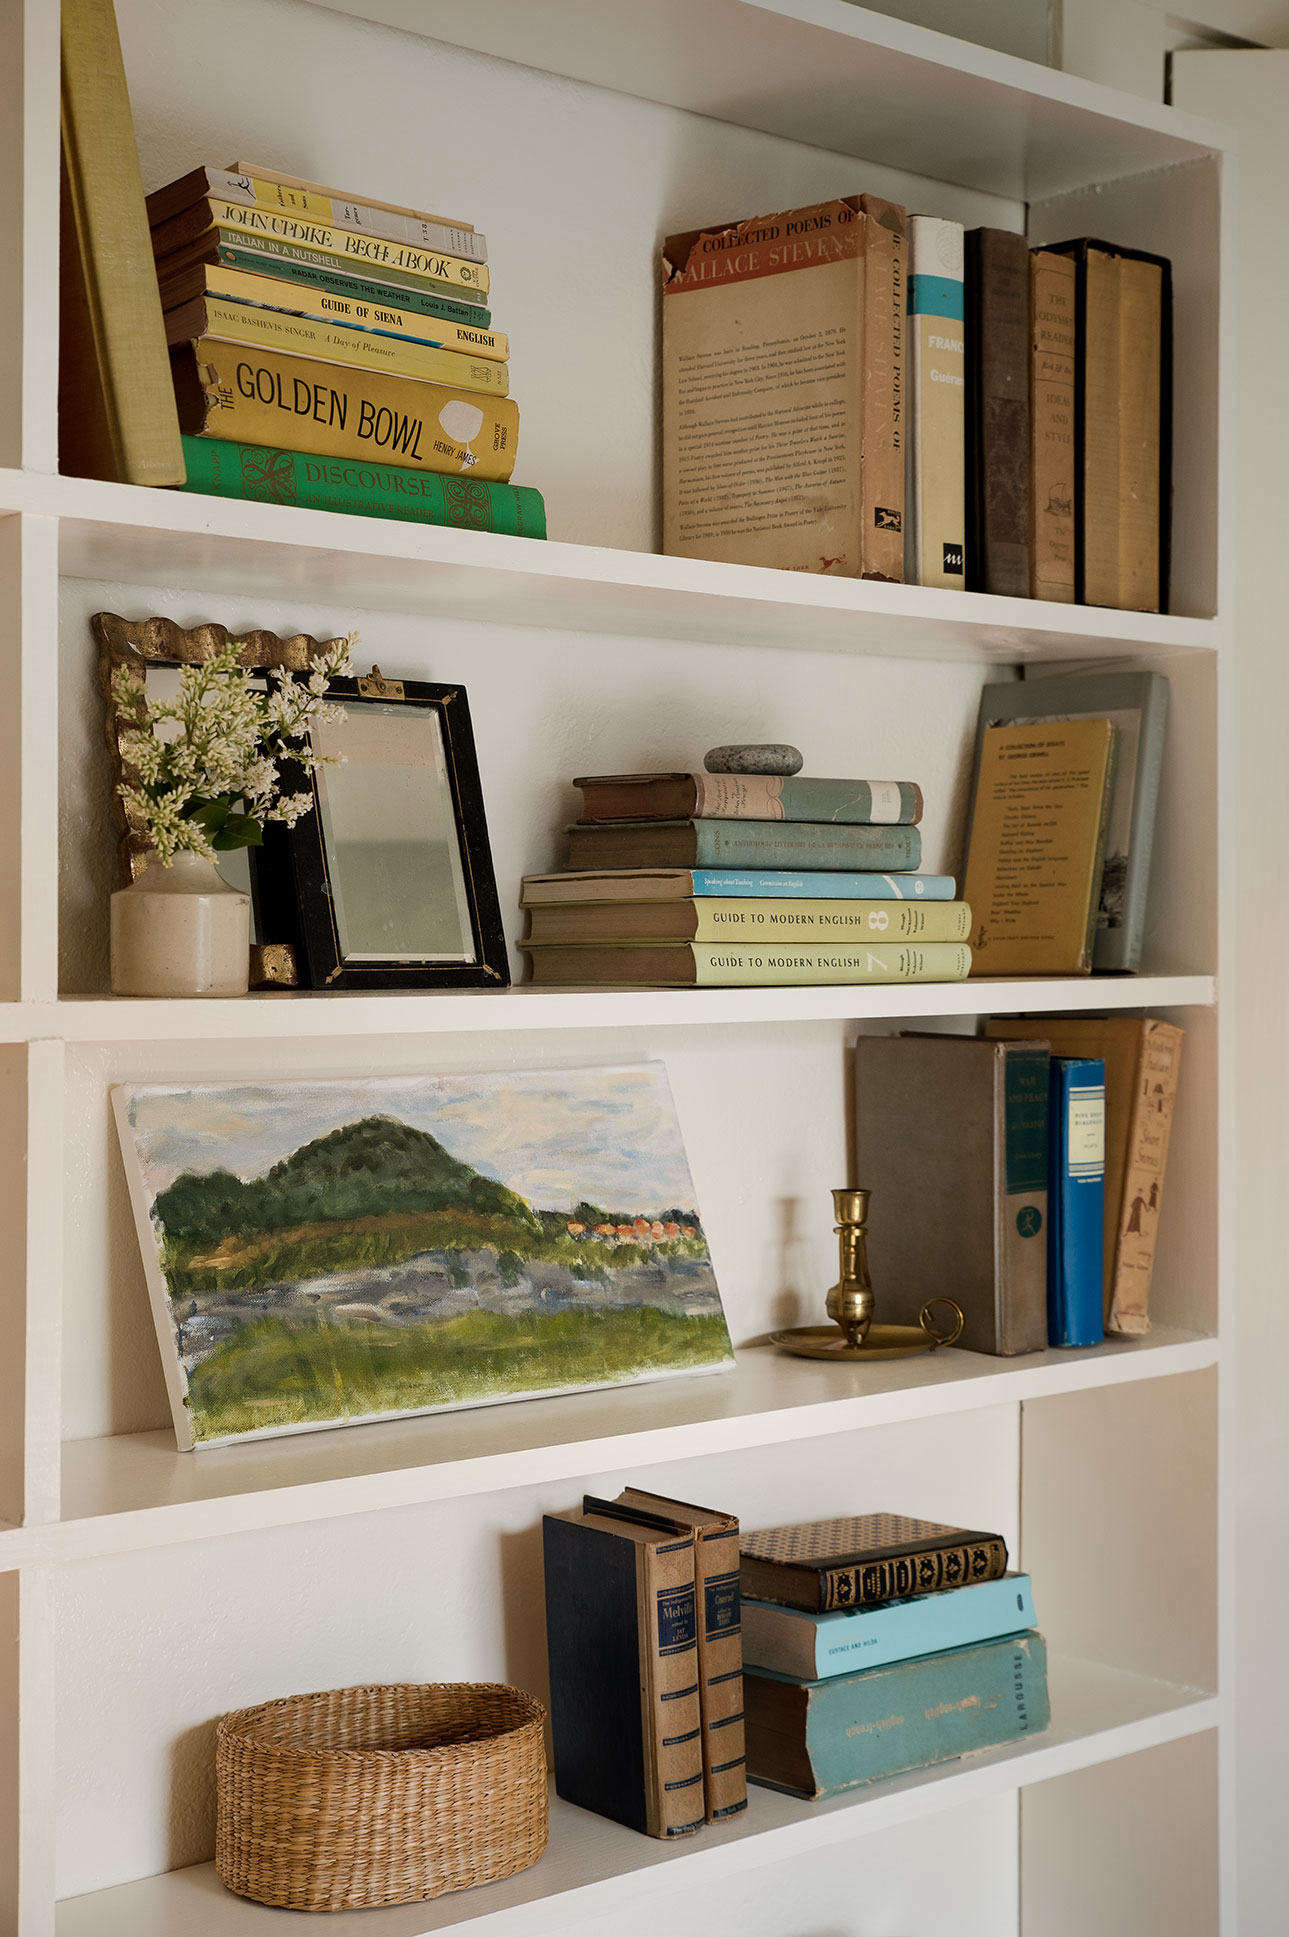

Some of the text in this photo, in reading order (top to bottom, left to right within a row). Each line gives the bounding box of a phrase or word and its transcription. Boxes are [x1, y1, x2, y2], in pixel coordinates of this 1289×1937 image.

[222, 206, 268, 230] JOHN
[272, 217, 333, 248] UPDIKE
[345, 236, 389, 261] BECH:
[392, 250, 404, 267] A
[405, 250, 452, 279] BOOK
[228, 232, 265, 249] ITALIAN
[268, 242, 280, 253] IN
[282, 246, 290, 255] A
[291, 250, 342, 269] NUTSHELL
[703, 225, 780, 253] COLLECTED
[786, 215, 832, 237] POEMS
[291, 268, 317, 280] RADAR
[319, 274, 358, 290] OBSERVES
[360, 284, 375, 295] THE
[377, 288, 411, 303] WEATHER
[321, 298, 496, 347] GUIDE OF SIENA ENGLISH
[892, 258, 901, 357] COLLECTED
[214, 310, 240, 323] ISAAC
[241, 316, 282, 331] BASHEVIS
[285, 326, 317, 340] SINGER
[333, 335, 350, 349] Day
[352, 341, 361, 351] of
[363, 343, 396, 357] Pleasure
[218, 362, 423, 461] THE GOLDEN BOWL
[892, 366, 901, 423] POEMS
[433, 440, 479, 466] HENRY JAMES
[492, 422, 501, 451] GROVE
[500, 426, 508, 451] PRESS
[305, 462, 433, 498] DISCOURSE
[713, 910, 889, 931] GUIDE TO MODERN ENGLISH 8
[710, 952, 888, 972] GUIDE TO MODERN ENGLISH 7
[1013, 1655, 1028, 1731] LAROUSSE
